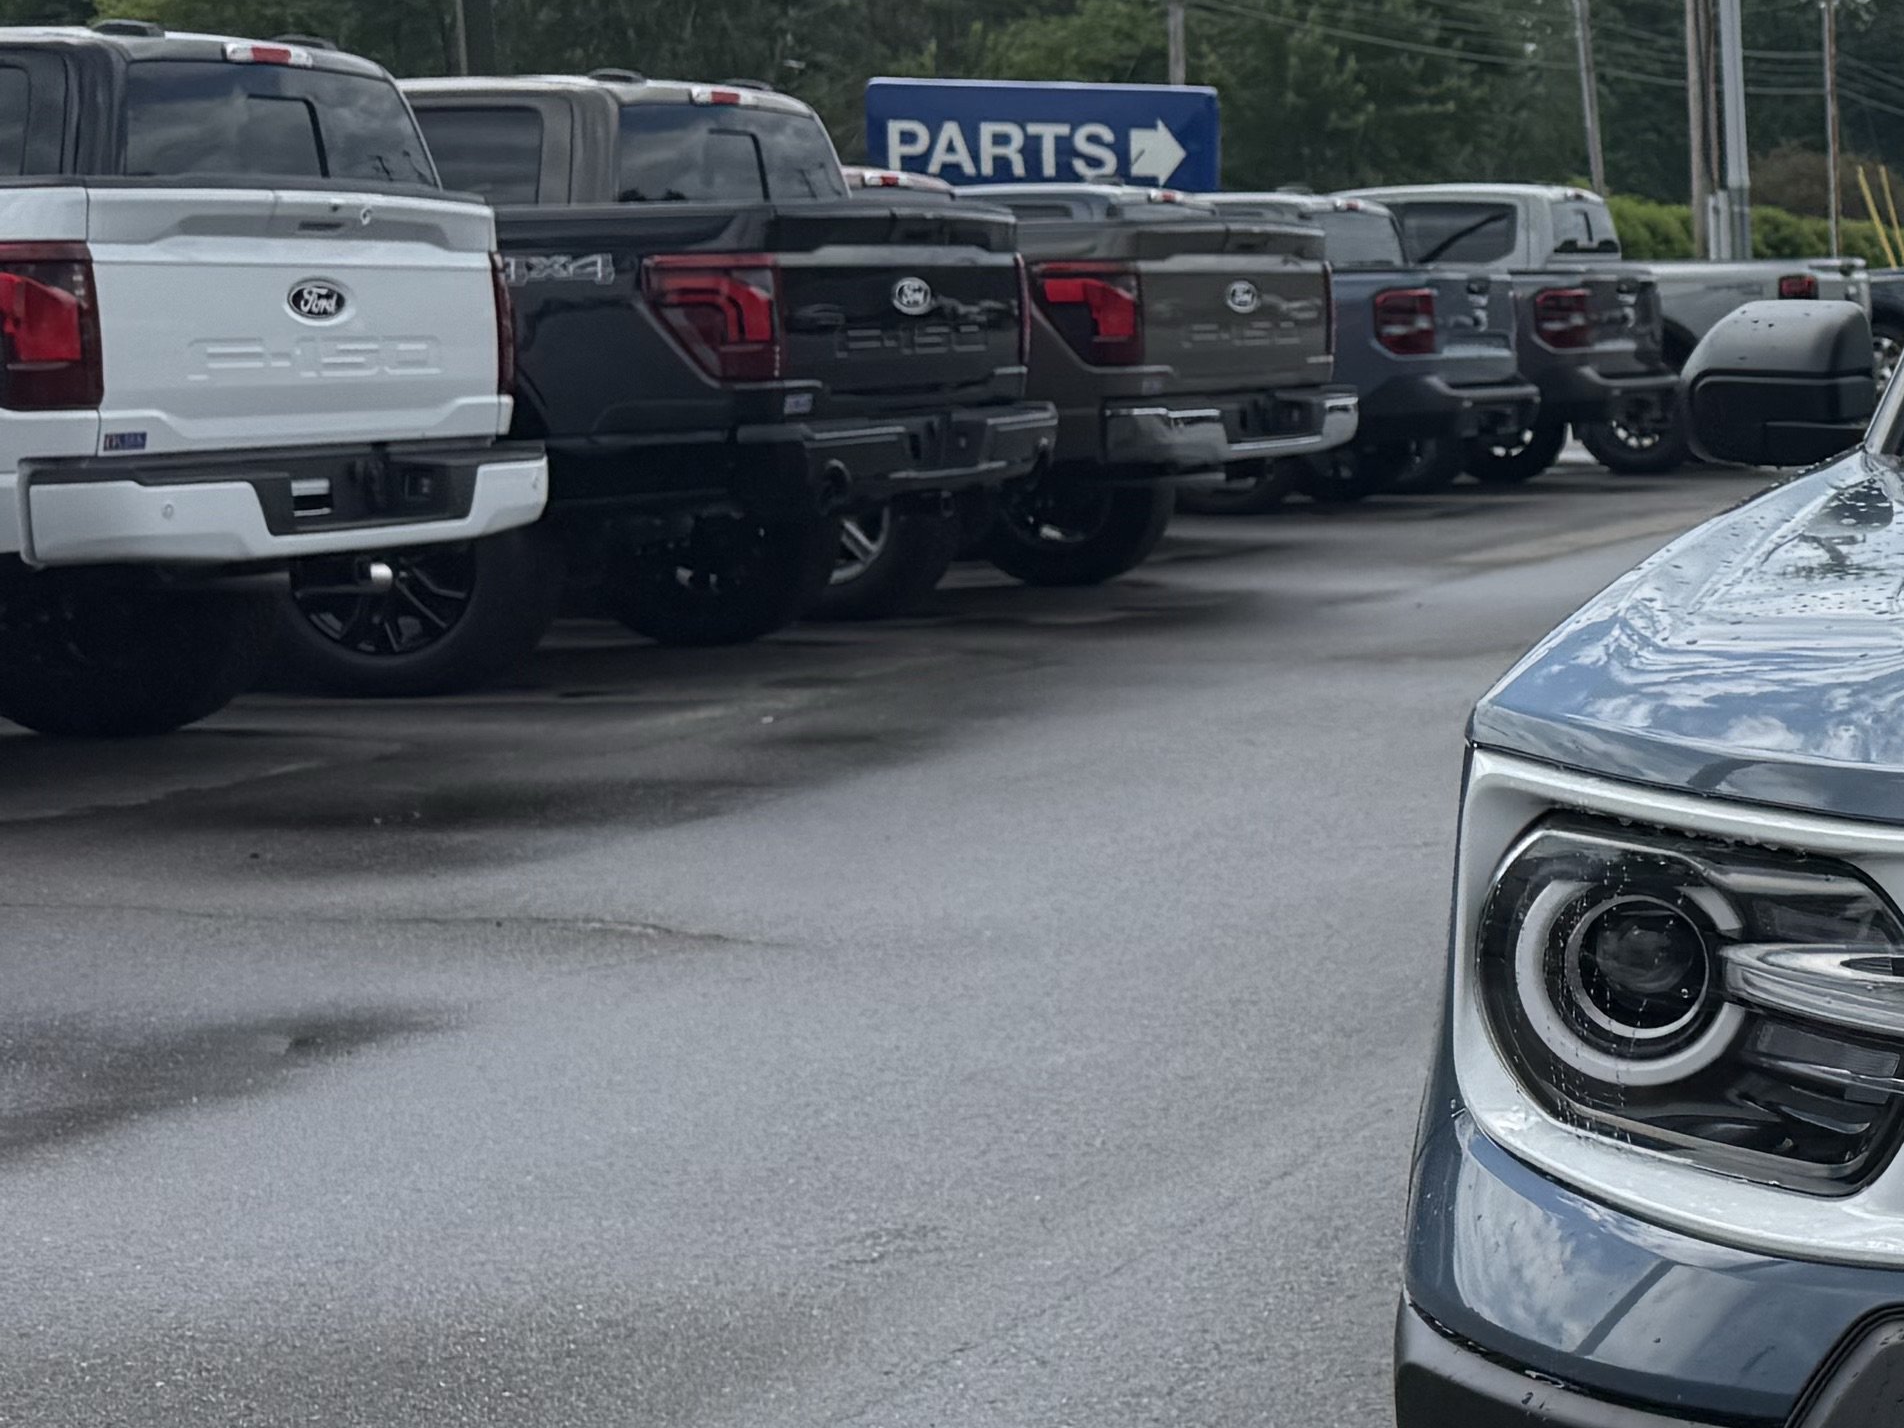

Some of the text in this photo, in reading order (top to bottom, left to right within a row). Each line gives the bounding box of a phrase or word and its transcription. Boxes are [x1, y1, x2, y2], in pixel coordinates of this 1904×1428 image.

[887, 118, 1118, 177] PARTS
[300, 286, 338, 314] Ford
[187, 334, 441, 380] F-150
